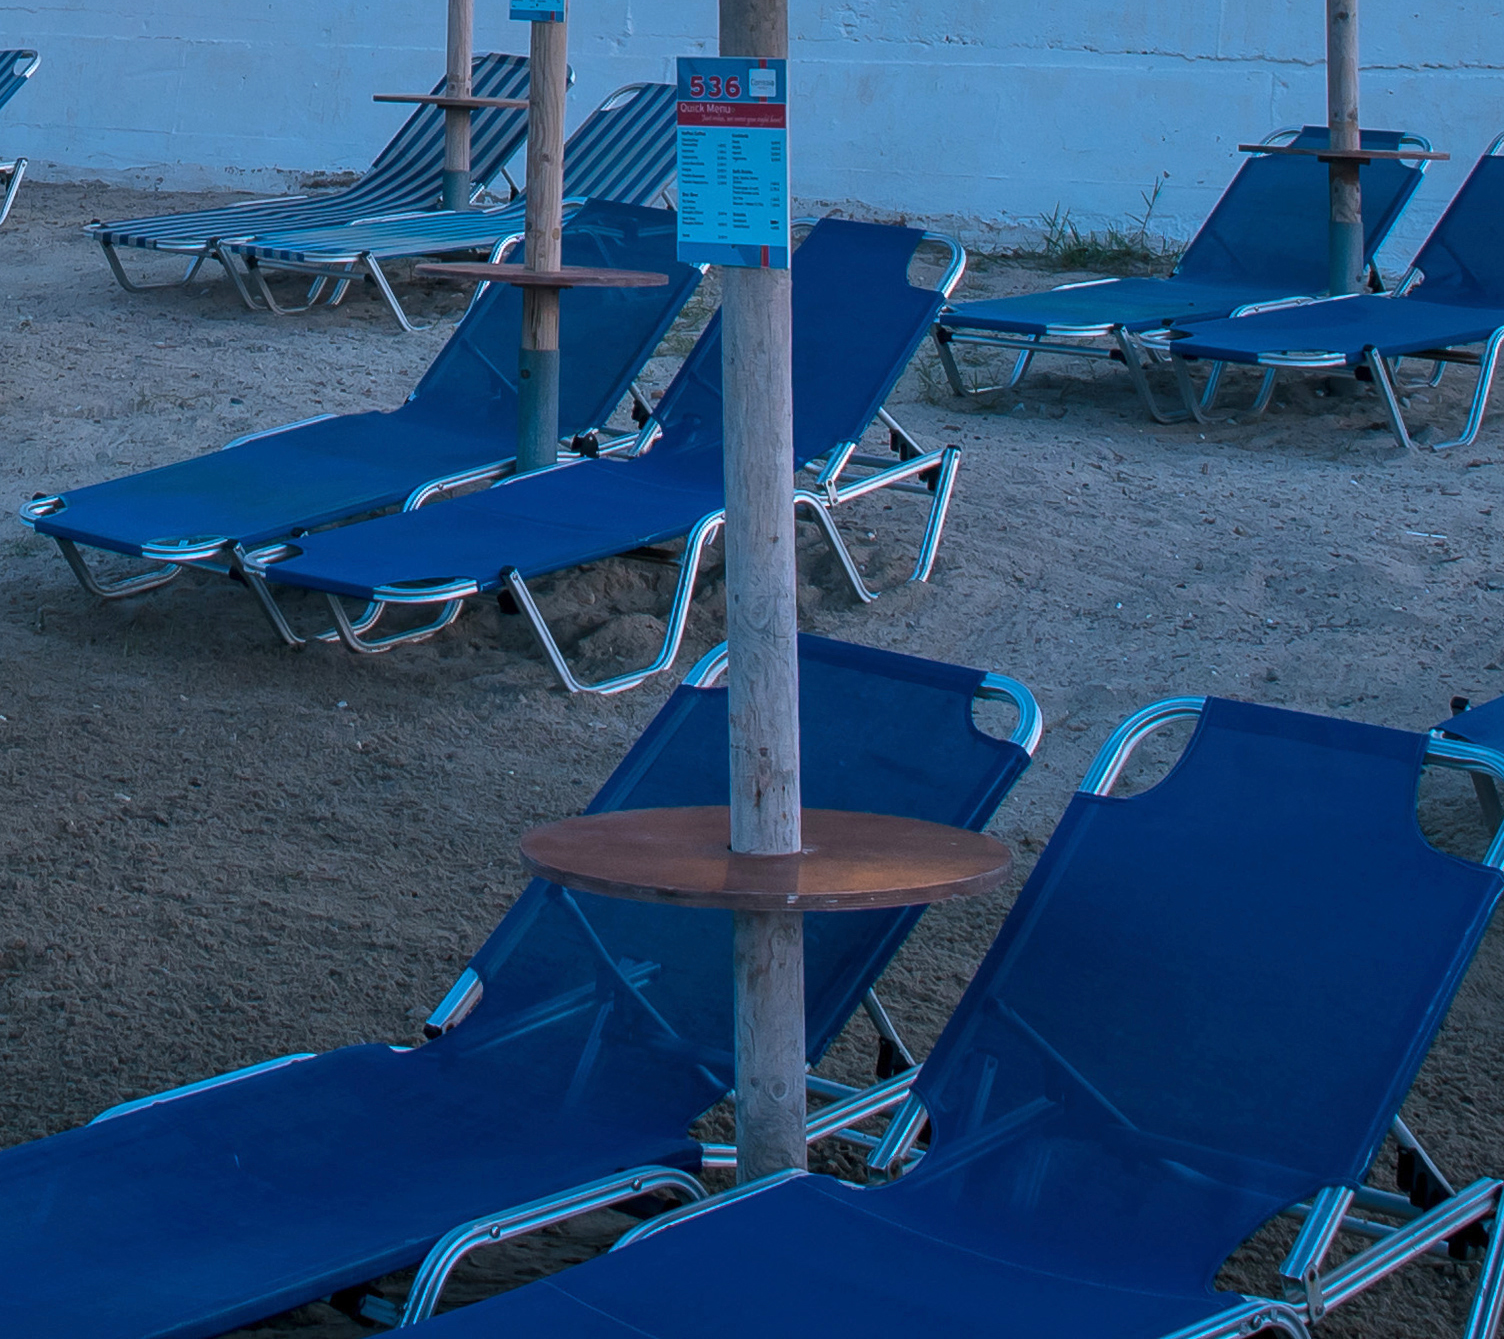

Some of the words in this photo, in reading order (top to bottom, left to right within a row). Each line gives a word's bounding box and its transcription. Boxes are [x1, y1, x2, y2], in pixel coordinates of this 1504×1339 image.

[690, 74, 742, 99] 536
[680, 103, 705, 114] Quick
[706, 104, 731, 114] Menu
